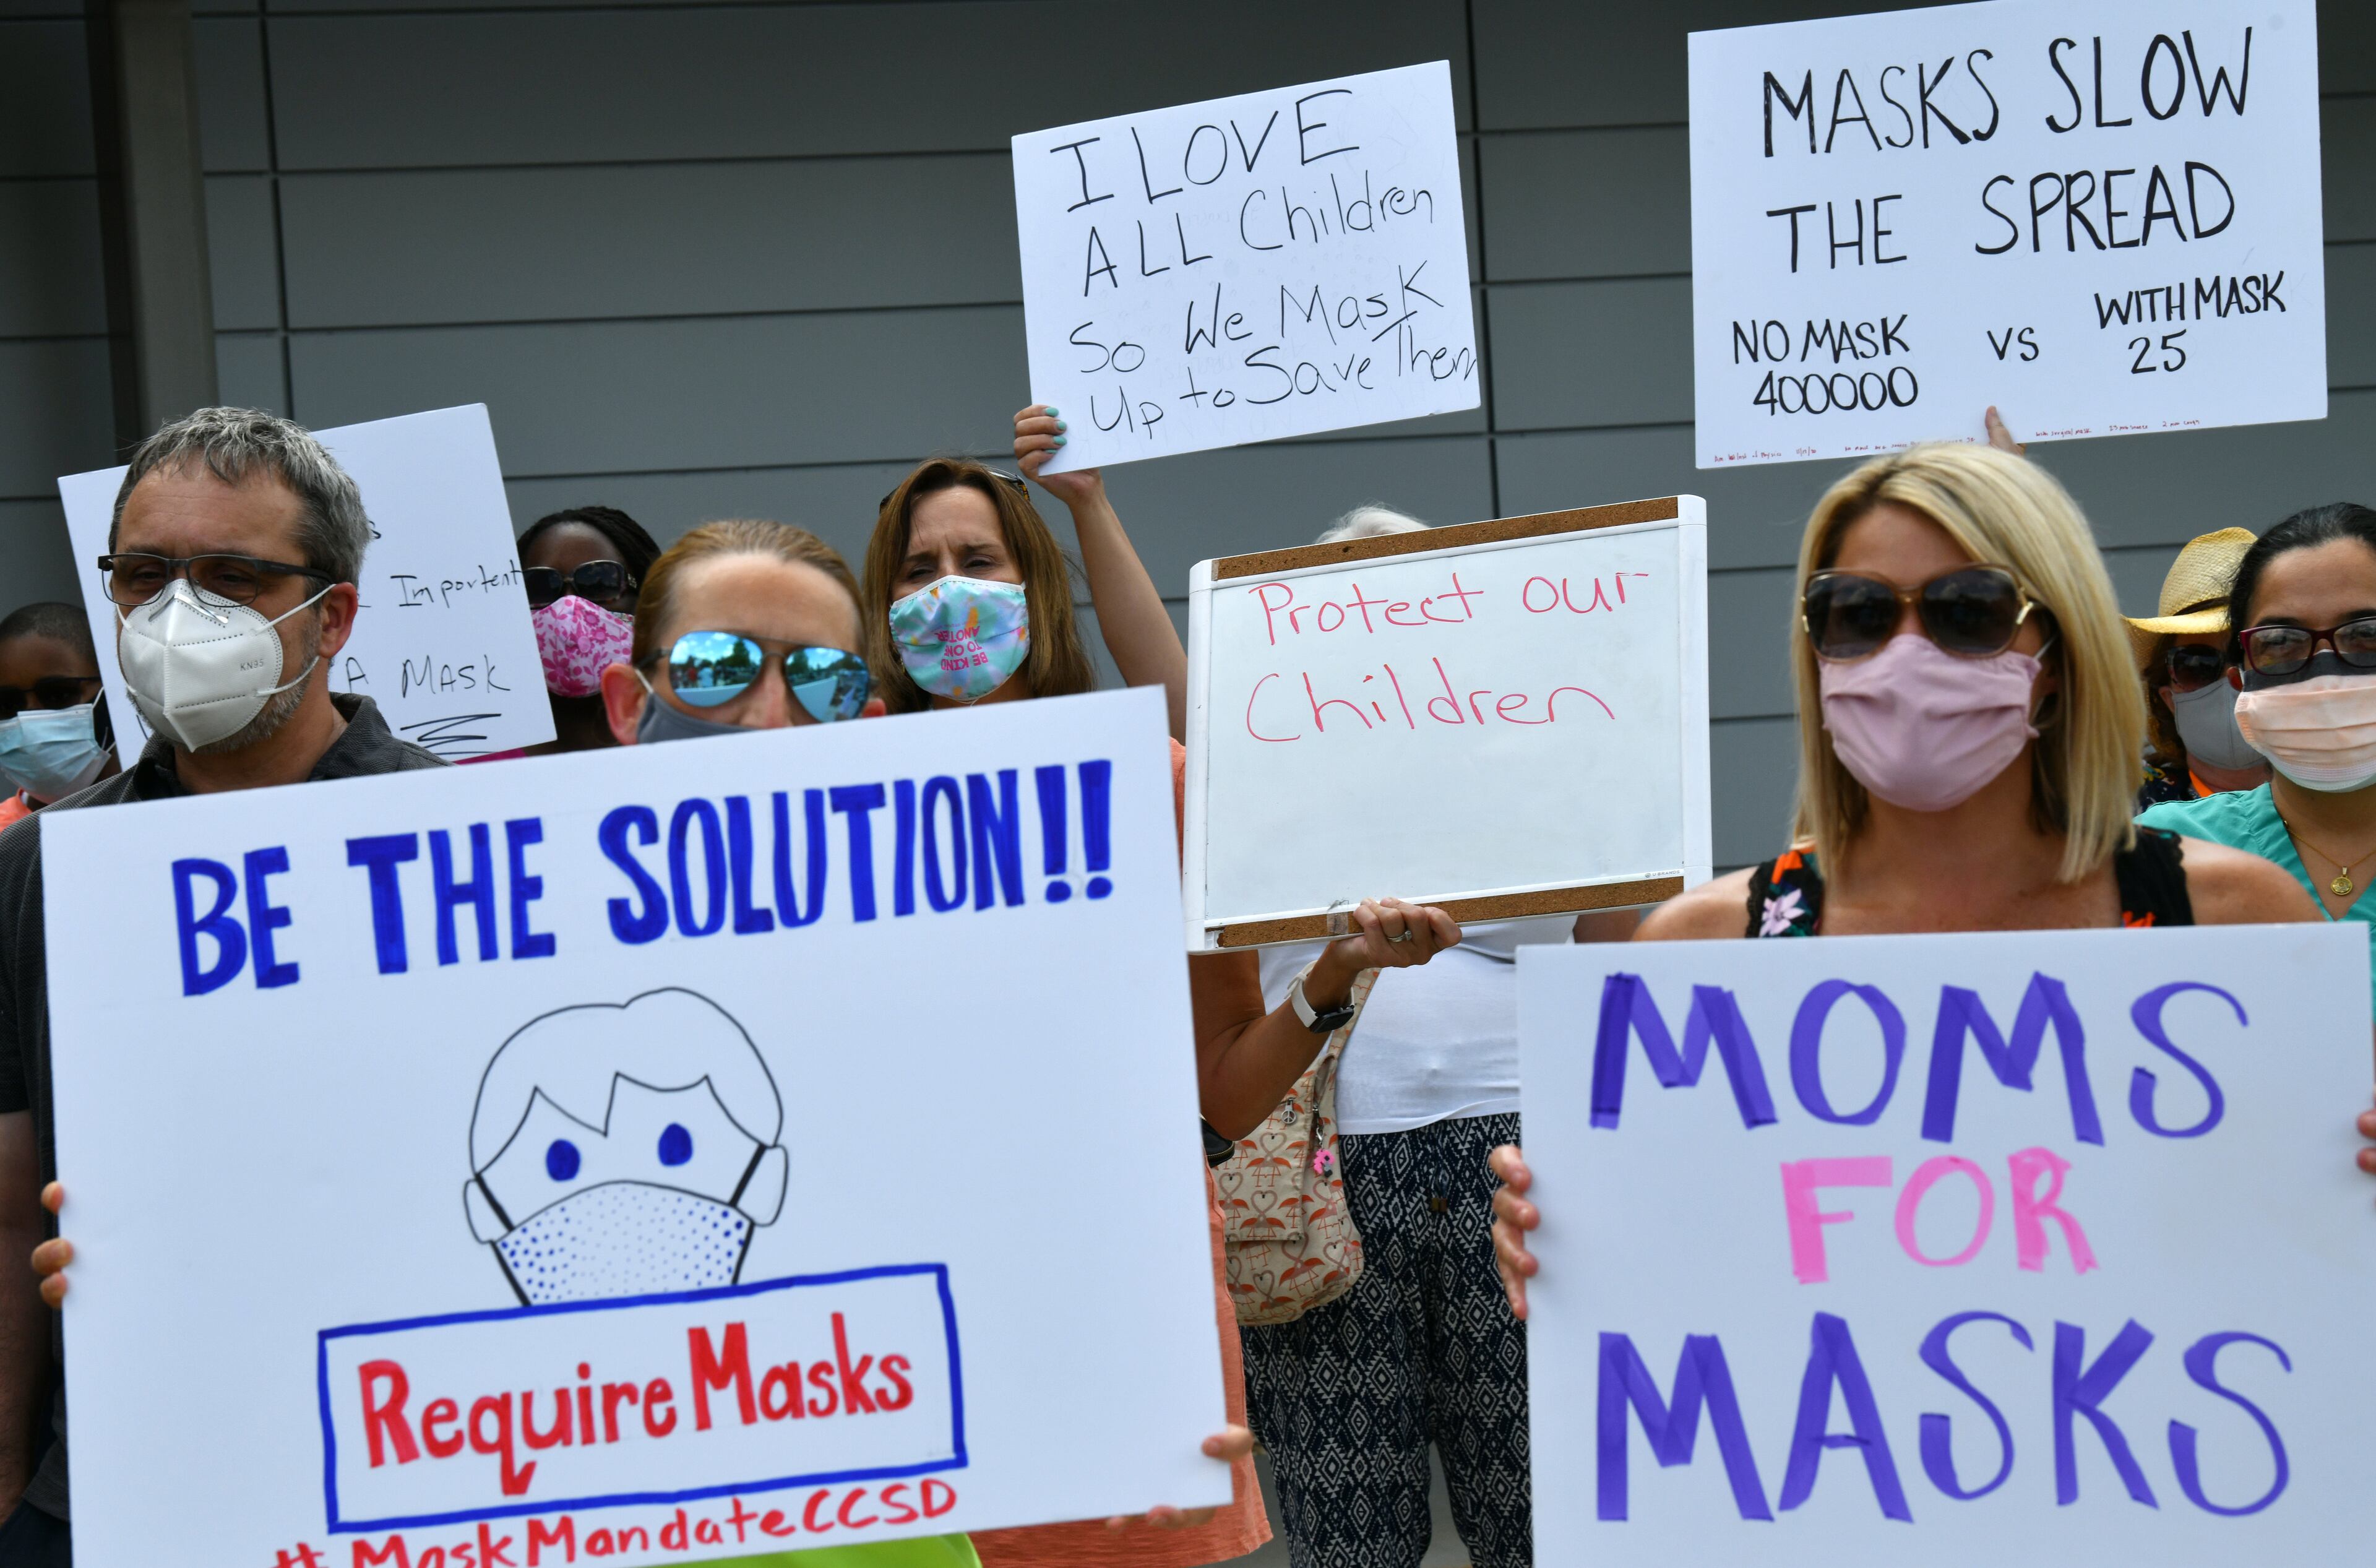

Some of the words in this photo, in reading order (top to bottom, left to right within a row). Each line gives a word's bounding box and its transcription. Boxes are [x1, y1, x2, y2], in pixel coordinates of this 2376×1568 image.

[1763, 50, 1999, 157] MASKS
[2046, 27, 2252, 133] SLOW
[1050, 137, 1114, 212] I
[1131, 90, 1360, 204] LOVE
[1084, 213, 1214, 298] ALL
[1241, 170, 1433, 250] Children
[1767, 194, 1907, 273] THE
[1975, 162, 2234, 254] SPREAD
[1186, 283, 1254, 355] We
[1281, 260, 1444, 345] Mask
[1733, 320, 1789, 364] NO
[1801, 314, 1909, 363] MASK
[2094, 283, 2187, 329] WITH
[2195, 270, 2286, 319] MASK
[1179, 367, 1235, 408] to
[1753, 366, 1918, 416] 400000
[2128, 329, 2186, 374] 25
[967, 639, 983, 653] TO
[1249, 572, 1484, 645] Protect
[1522, 572, 1649, 614] our
[240, 658, 264, 671] KN95
[345, 657, 368, 693] A
[402, 655, 510, 698] MASK
[940, 657, 970, 671] KIND
[972, 652, 989, 666] BE
[1247, 657, 1615, 742] Children
[172, 846, 300, 997] BE
[346, 817, 556, 975] THE
[598, 760, 1113, 945] SOLUTION!!
[1589, 971, 2249, 1148] MOMS
[1780, 1147, 2101, 1285] FOR
[358, 1359, 678, 1496] Require
[687, 1312, 914, 1431] Masks
[1596, 1310, 2293, 1524] MASKS
